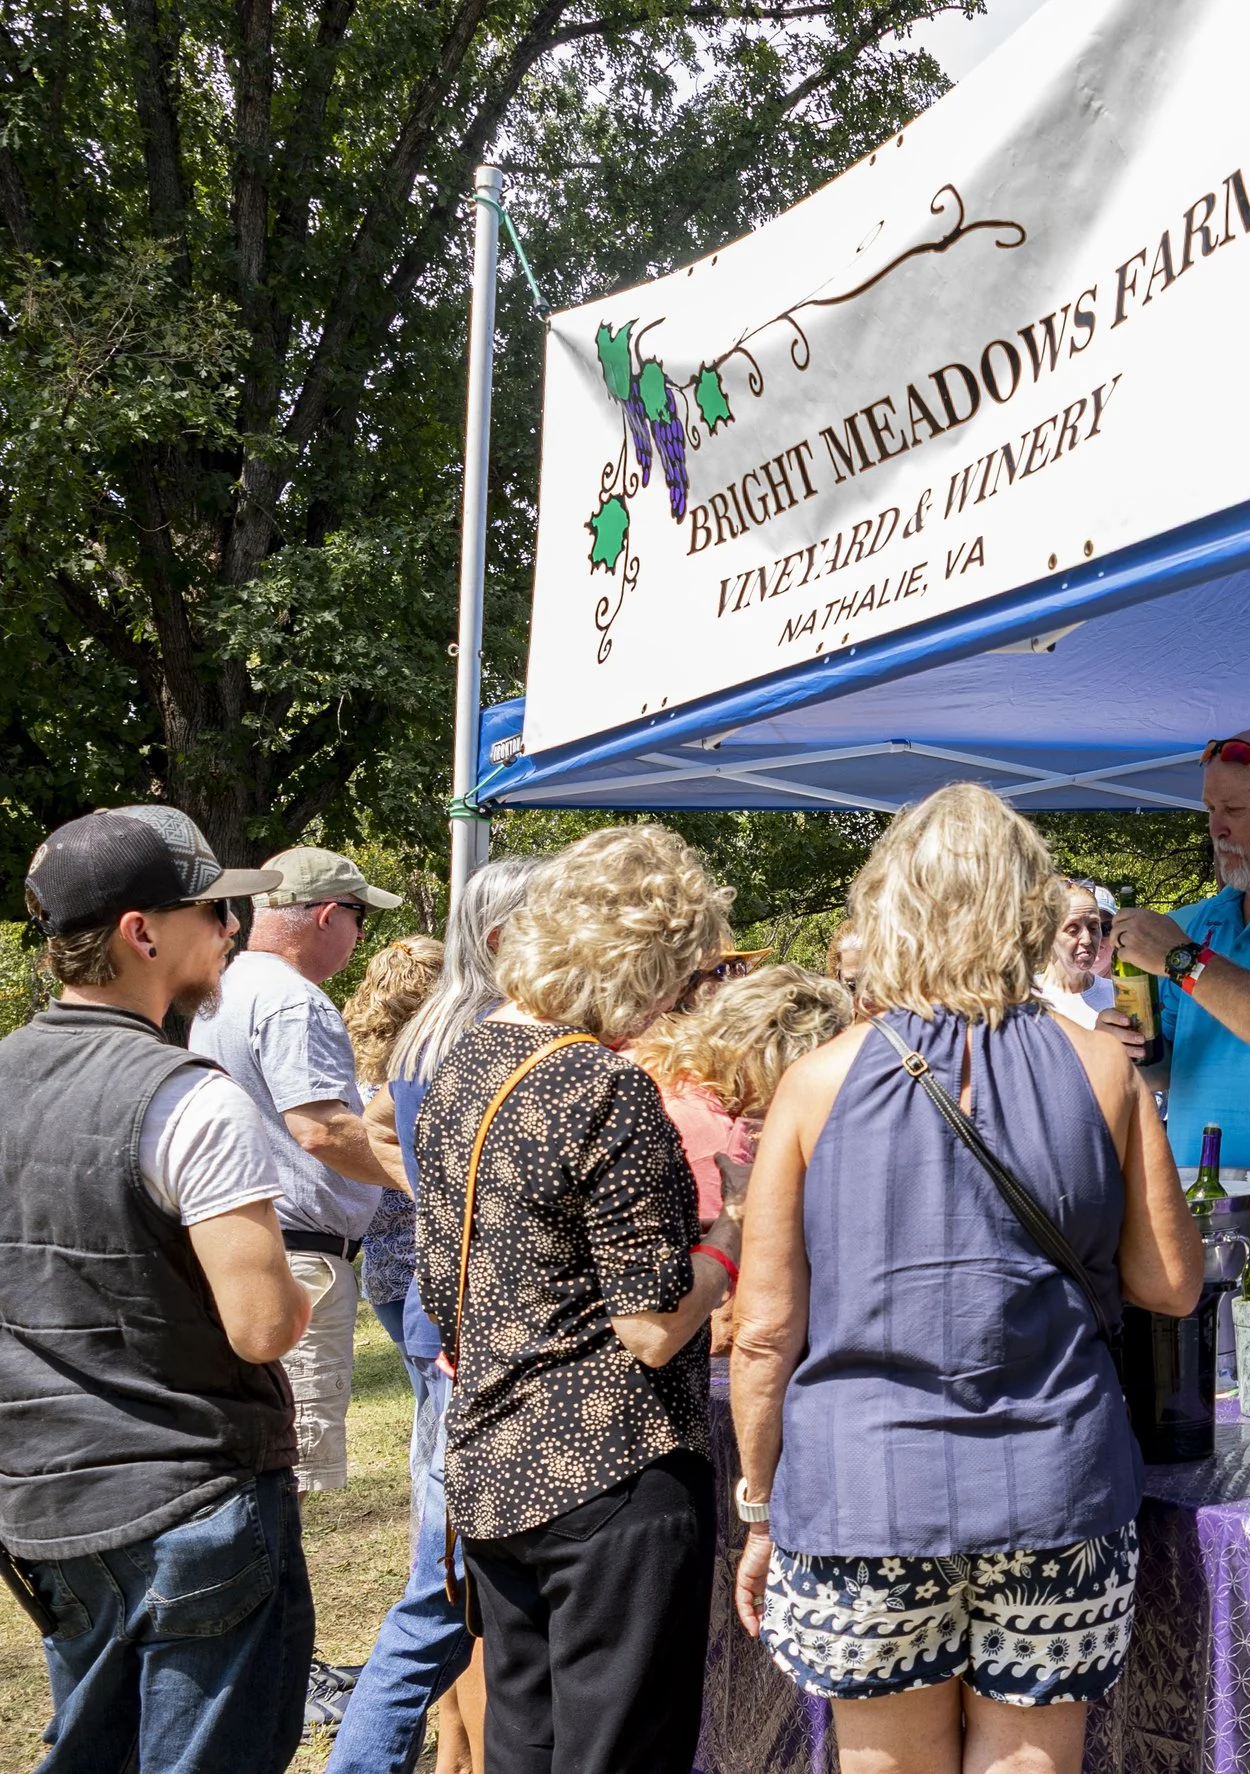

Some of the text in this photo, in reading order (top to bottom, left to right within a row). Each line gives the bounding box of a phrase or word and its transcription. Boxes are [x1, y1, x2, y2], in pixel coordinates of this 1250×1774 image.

[687, 439, 818, 556] BRIGHT
[819, 284, 1100, 485] MEADOWS
[716, 373, 1123, 619] VINEYARD & WINERY
[778, 535, 986, 647] NATHALIE, VA
